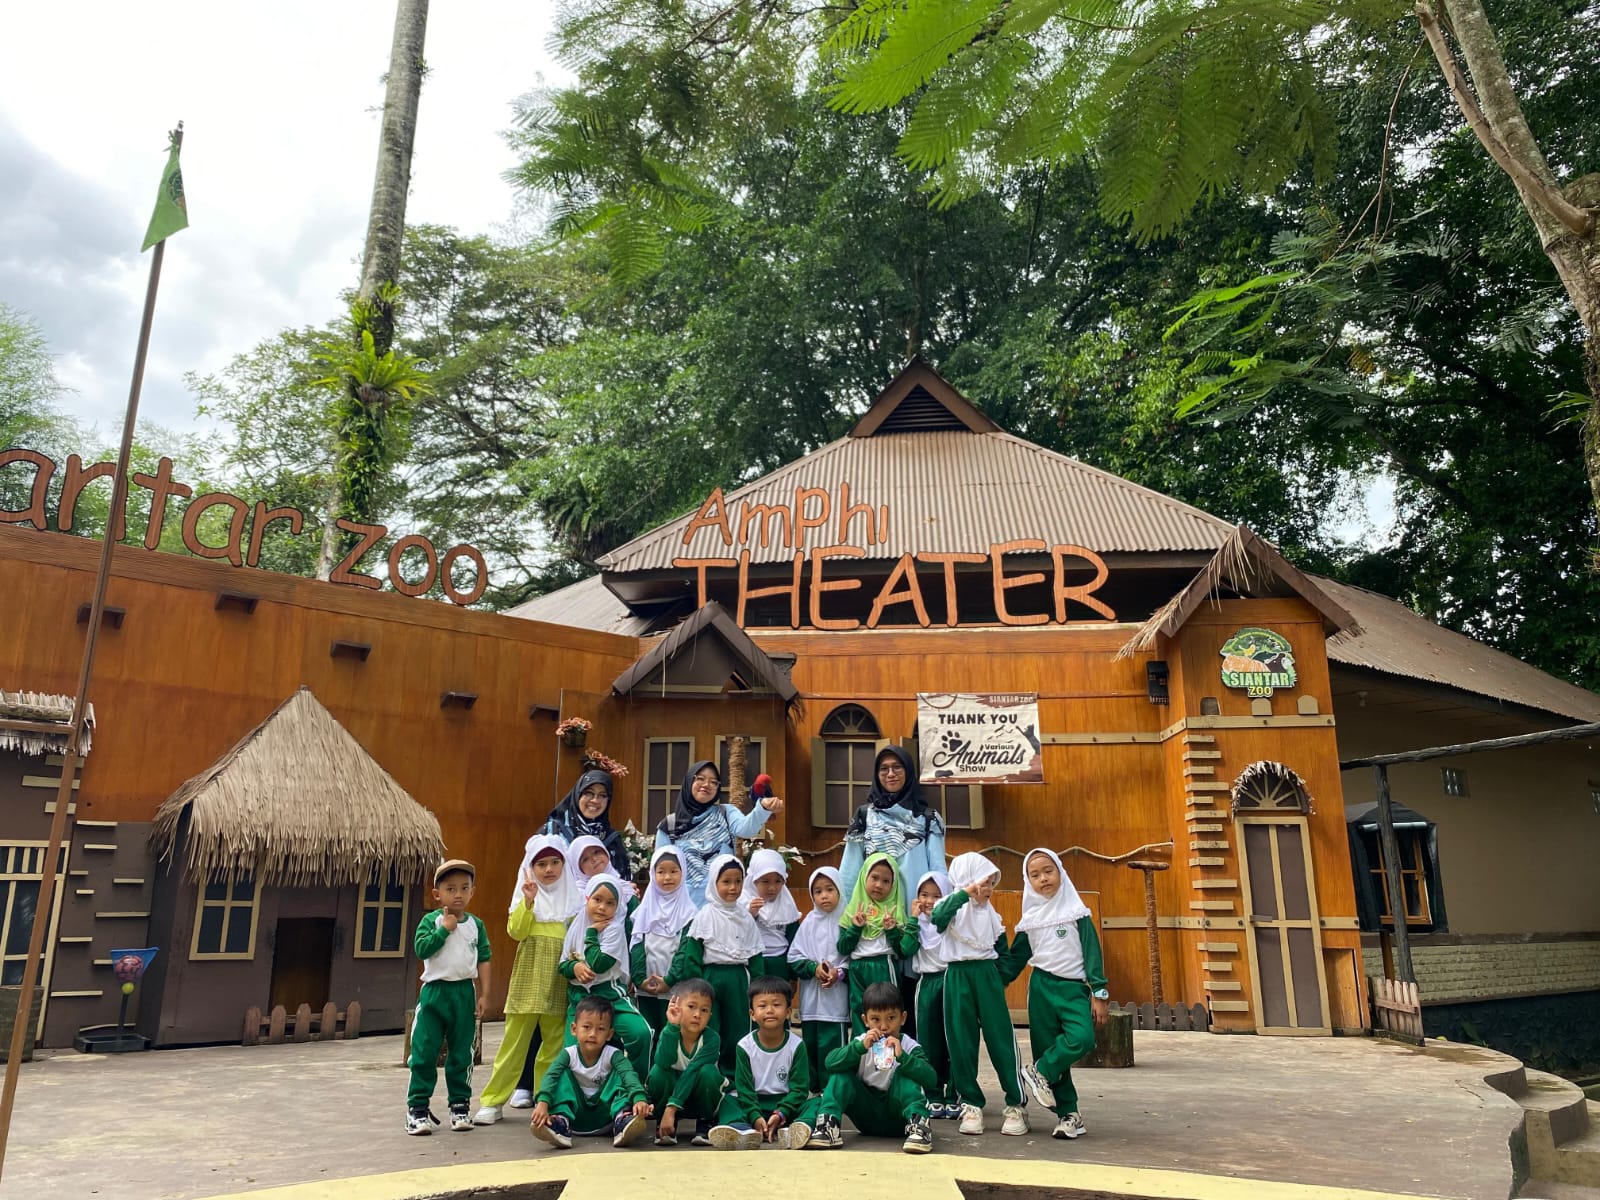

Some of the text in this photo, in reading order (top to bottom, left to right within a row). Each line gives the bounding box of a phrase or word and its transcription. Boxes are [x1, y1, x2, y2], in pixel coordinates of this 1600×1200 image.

[672, 538, 1117, 630] THEATER
[1230, 672, 1289, 686] SIANTAR
[1249, 686, 1272, 696] ZOO
[938, 713, 1018, 725] THANK YOU
[984, 743, 1015, 751] Various
[932, 740, 1026, 768] Animals
[959, 764, 986, 773] Show
